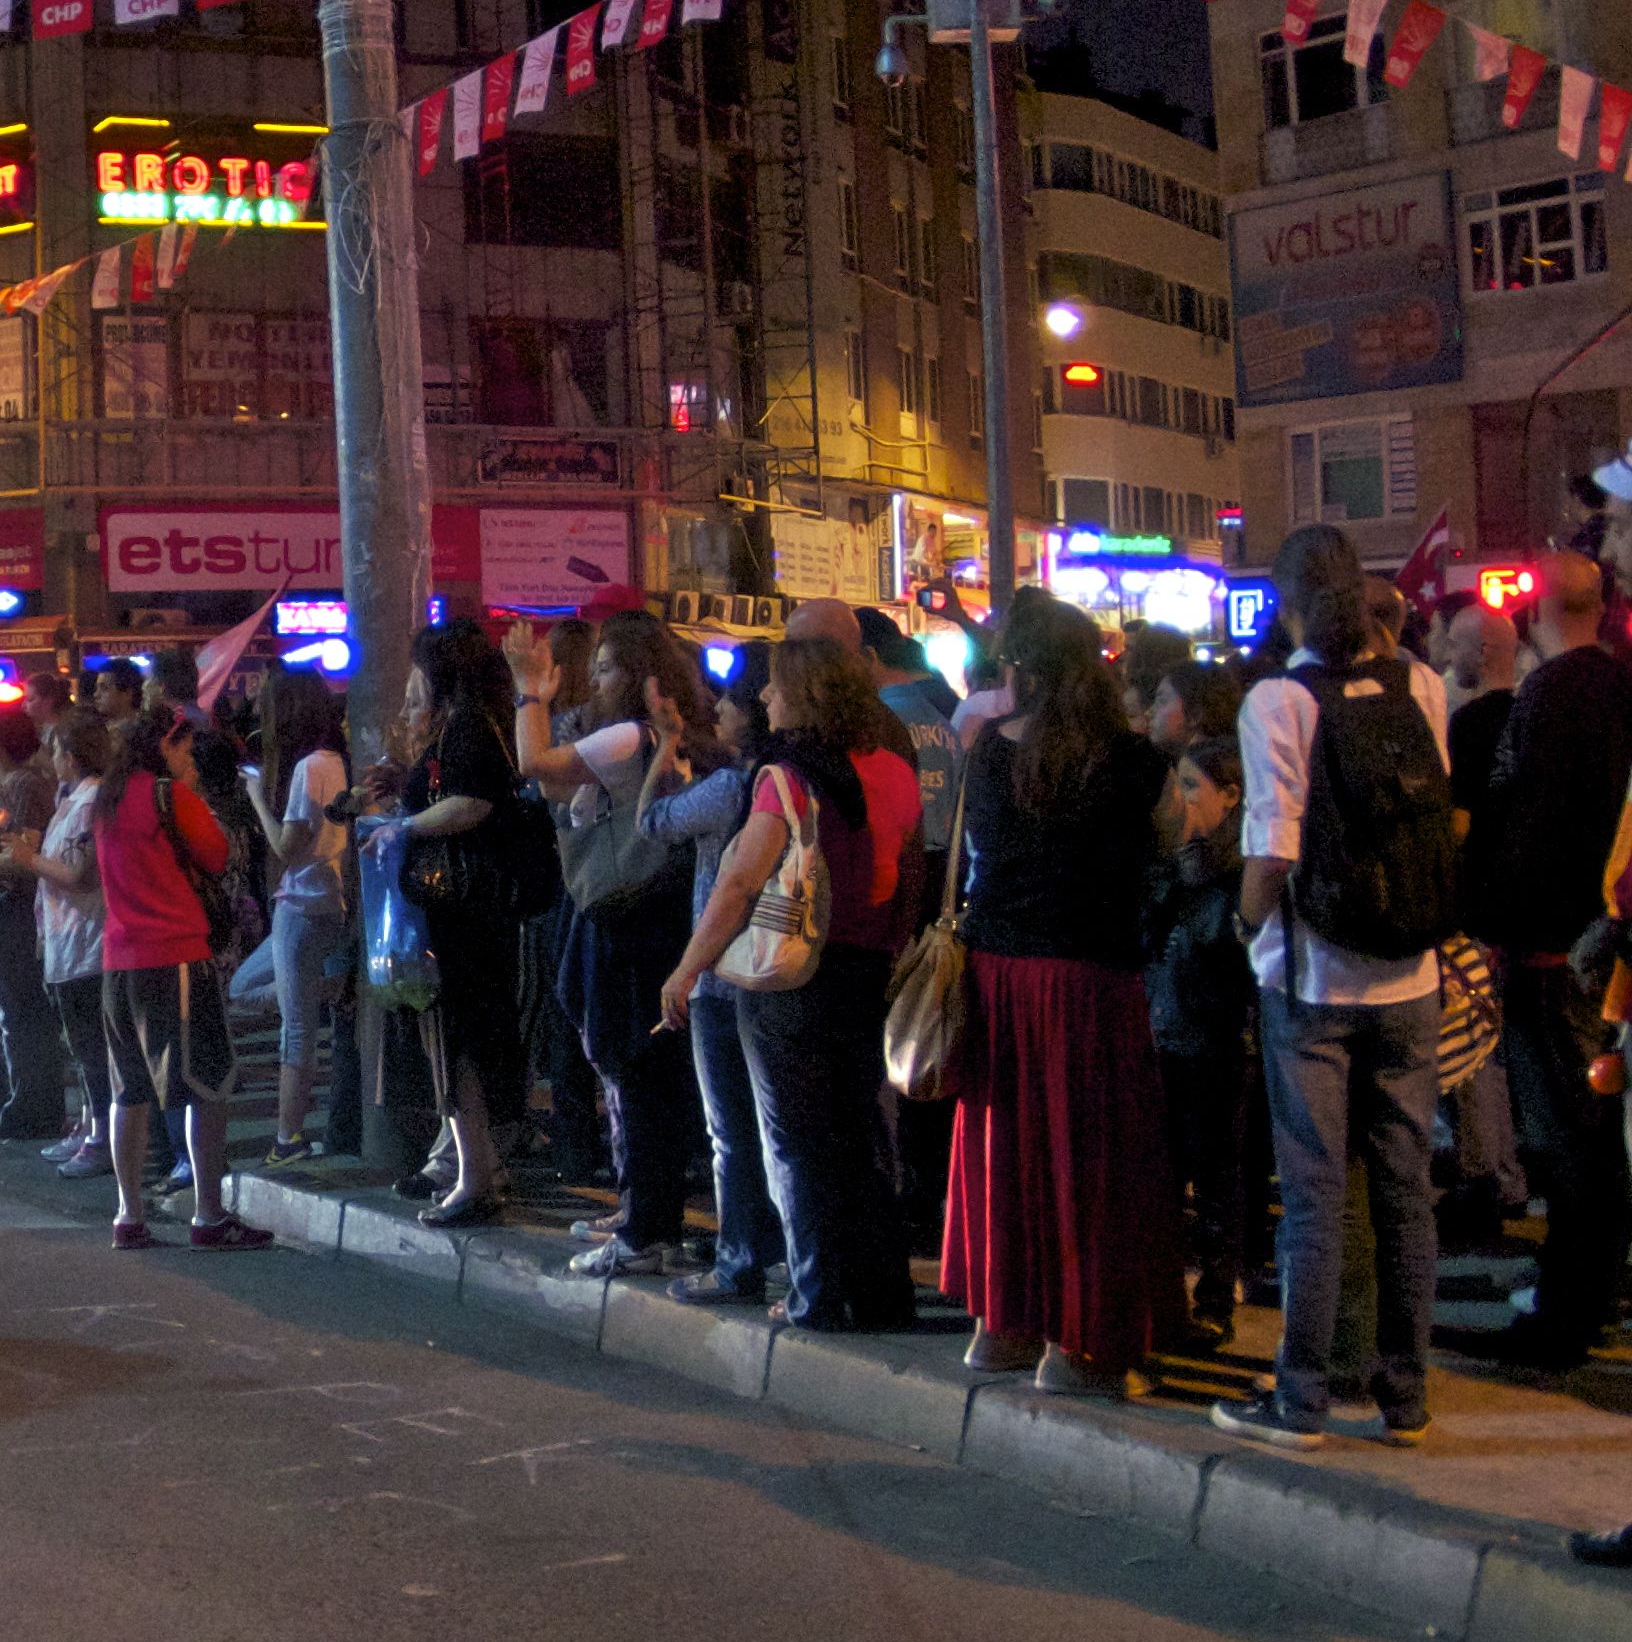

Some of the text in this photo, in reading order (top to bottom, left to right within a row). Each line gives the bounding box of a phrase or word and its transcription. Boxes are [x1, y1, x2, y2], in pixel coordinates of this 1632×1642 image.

[41, 1, 83, 26] CHP
[97, 152, 309, 200] EROTIC
[119, 527, 341, 576] etstur
